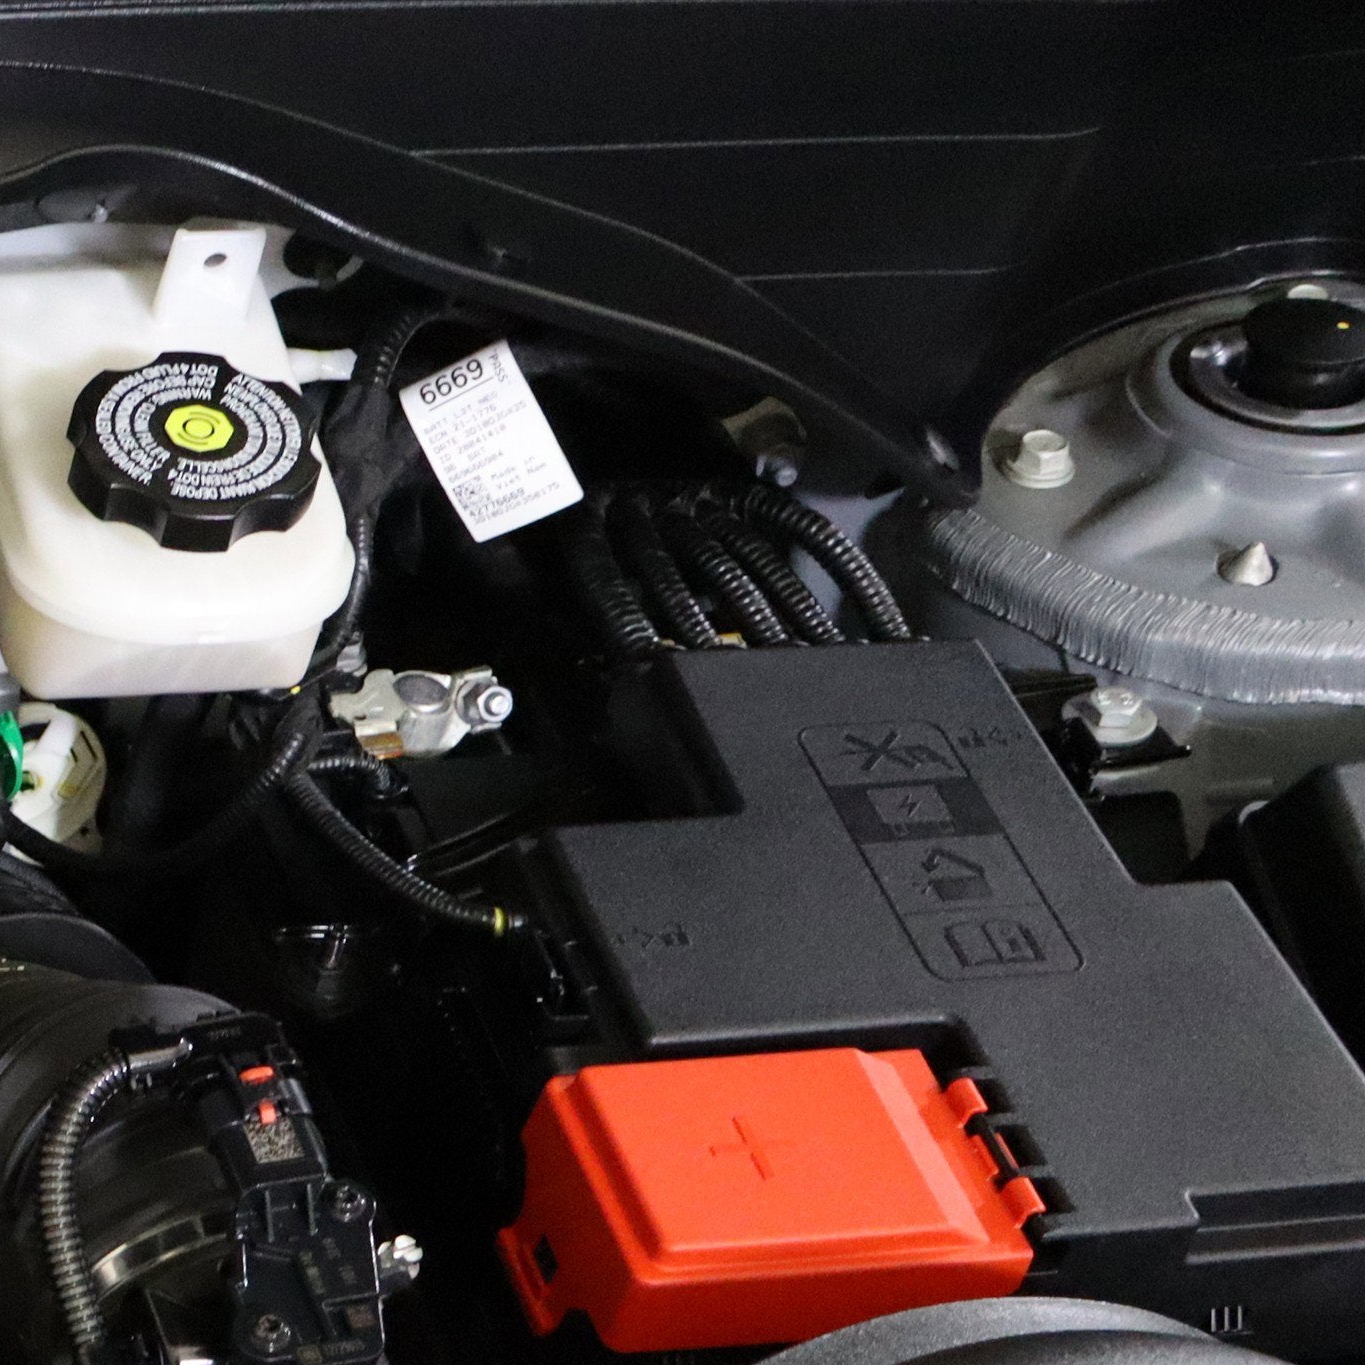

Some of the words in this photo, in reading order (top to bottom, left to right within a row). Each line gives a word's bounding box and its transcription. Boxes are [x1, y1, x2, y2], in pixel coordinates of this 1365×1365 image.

[142, 364, 180, 380] FLUID
[190, 363, 218, 377] DOT
[487, 353, 508, 382] PASS
[187, 374, 216, 389] CAP
[418, 358, 483, 404] 6669
[130, 448, 163, 472] ONLY
[176, 471, 200, 486] DOT
[496, 474, 519, 489] Viet
